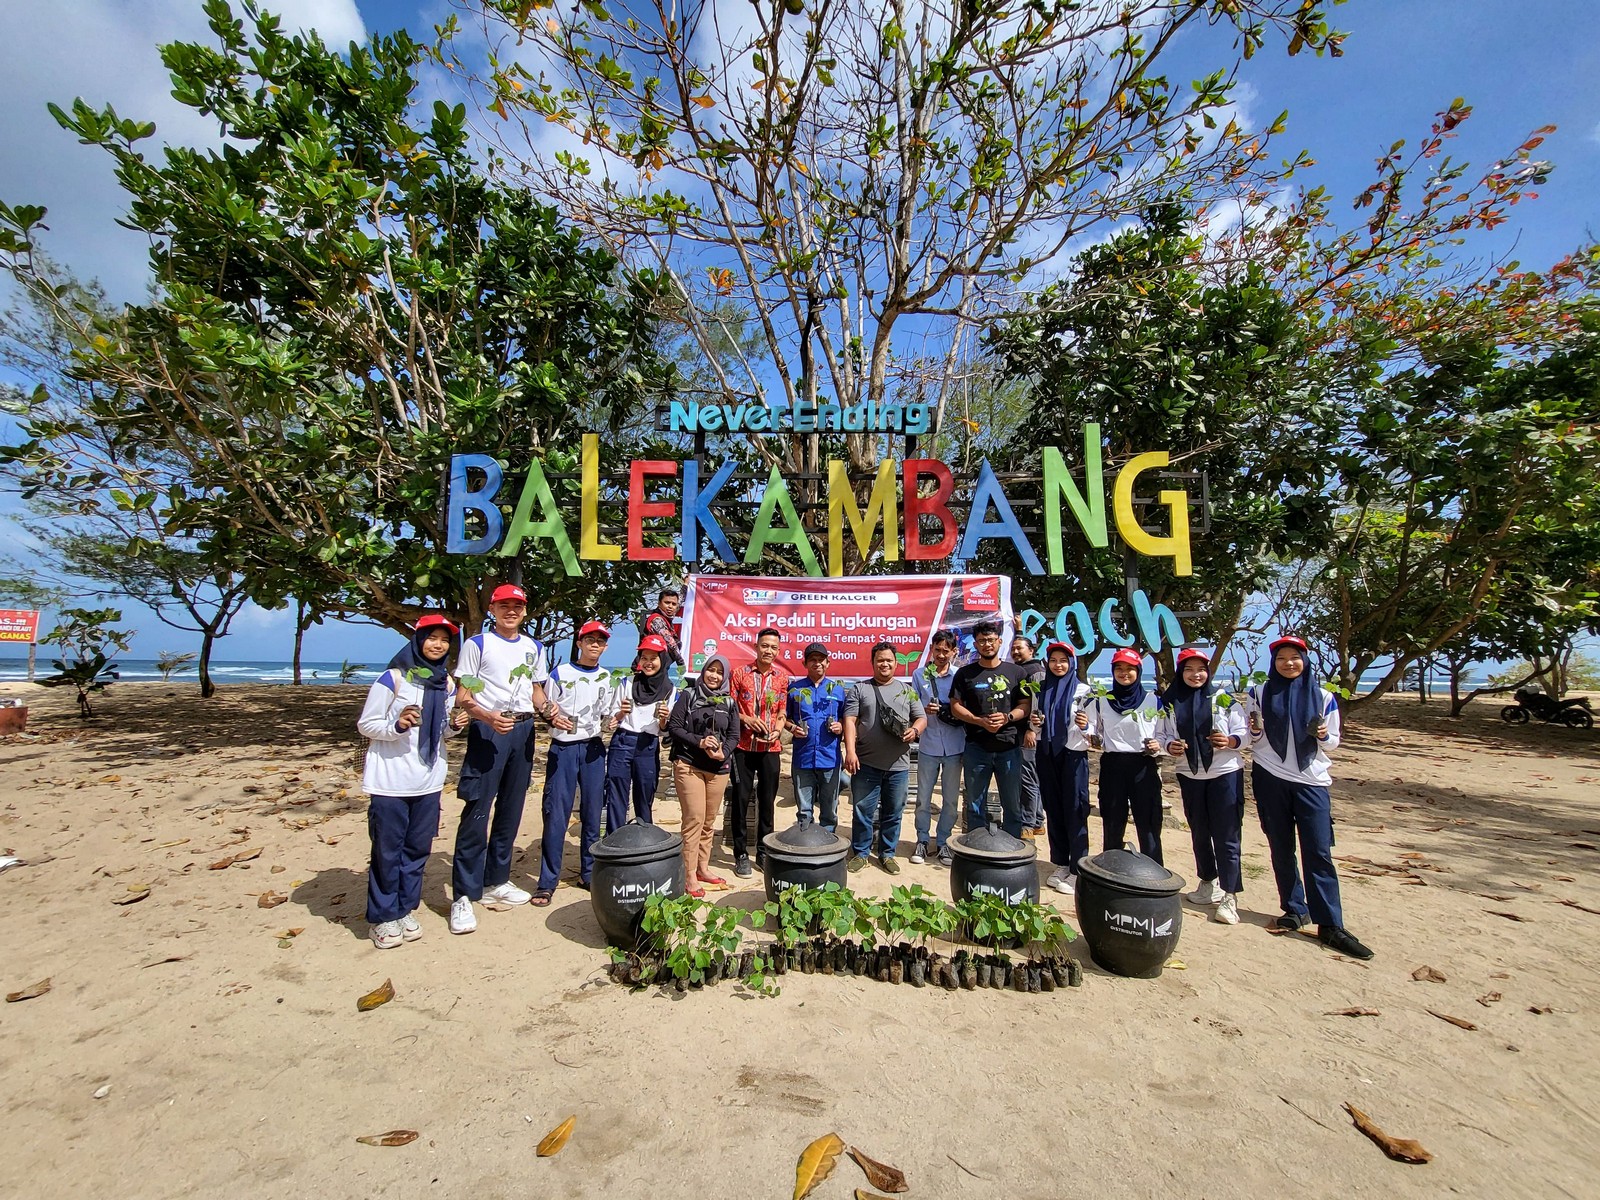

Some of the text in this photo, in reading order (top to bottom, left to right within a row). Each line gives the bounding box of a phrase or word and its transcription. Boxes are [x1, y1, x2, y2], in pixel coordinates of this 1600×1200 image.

[670, 399, 929, 435] Never Ending
[446, 422, 1193, 577] BALEKAMBANG
[790, 593, 828, 601] GREEN
[724, 612, 917, 631] Aksi Peduli Lingkungan
[1020, 589, 1185, 661] each
[720, 631, 752, 643] Bersih
[796, 633, 831, 643] Donasi
[834, 633, 876, 645] Tempat
[879, 633, 921, 645] Sampah
[784, 651, 791, 660] &
[612, 882, 650, 897] MPM
[967, 881, 1004, 899] MPM
[1104, 909, 1149, 930] MPM
[1110, 925, 1143, 937] DISTRIBUTOR
